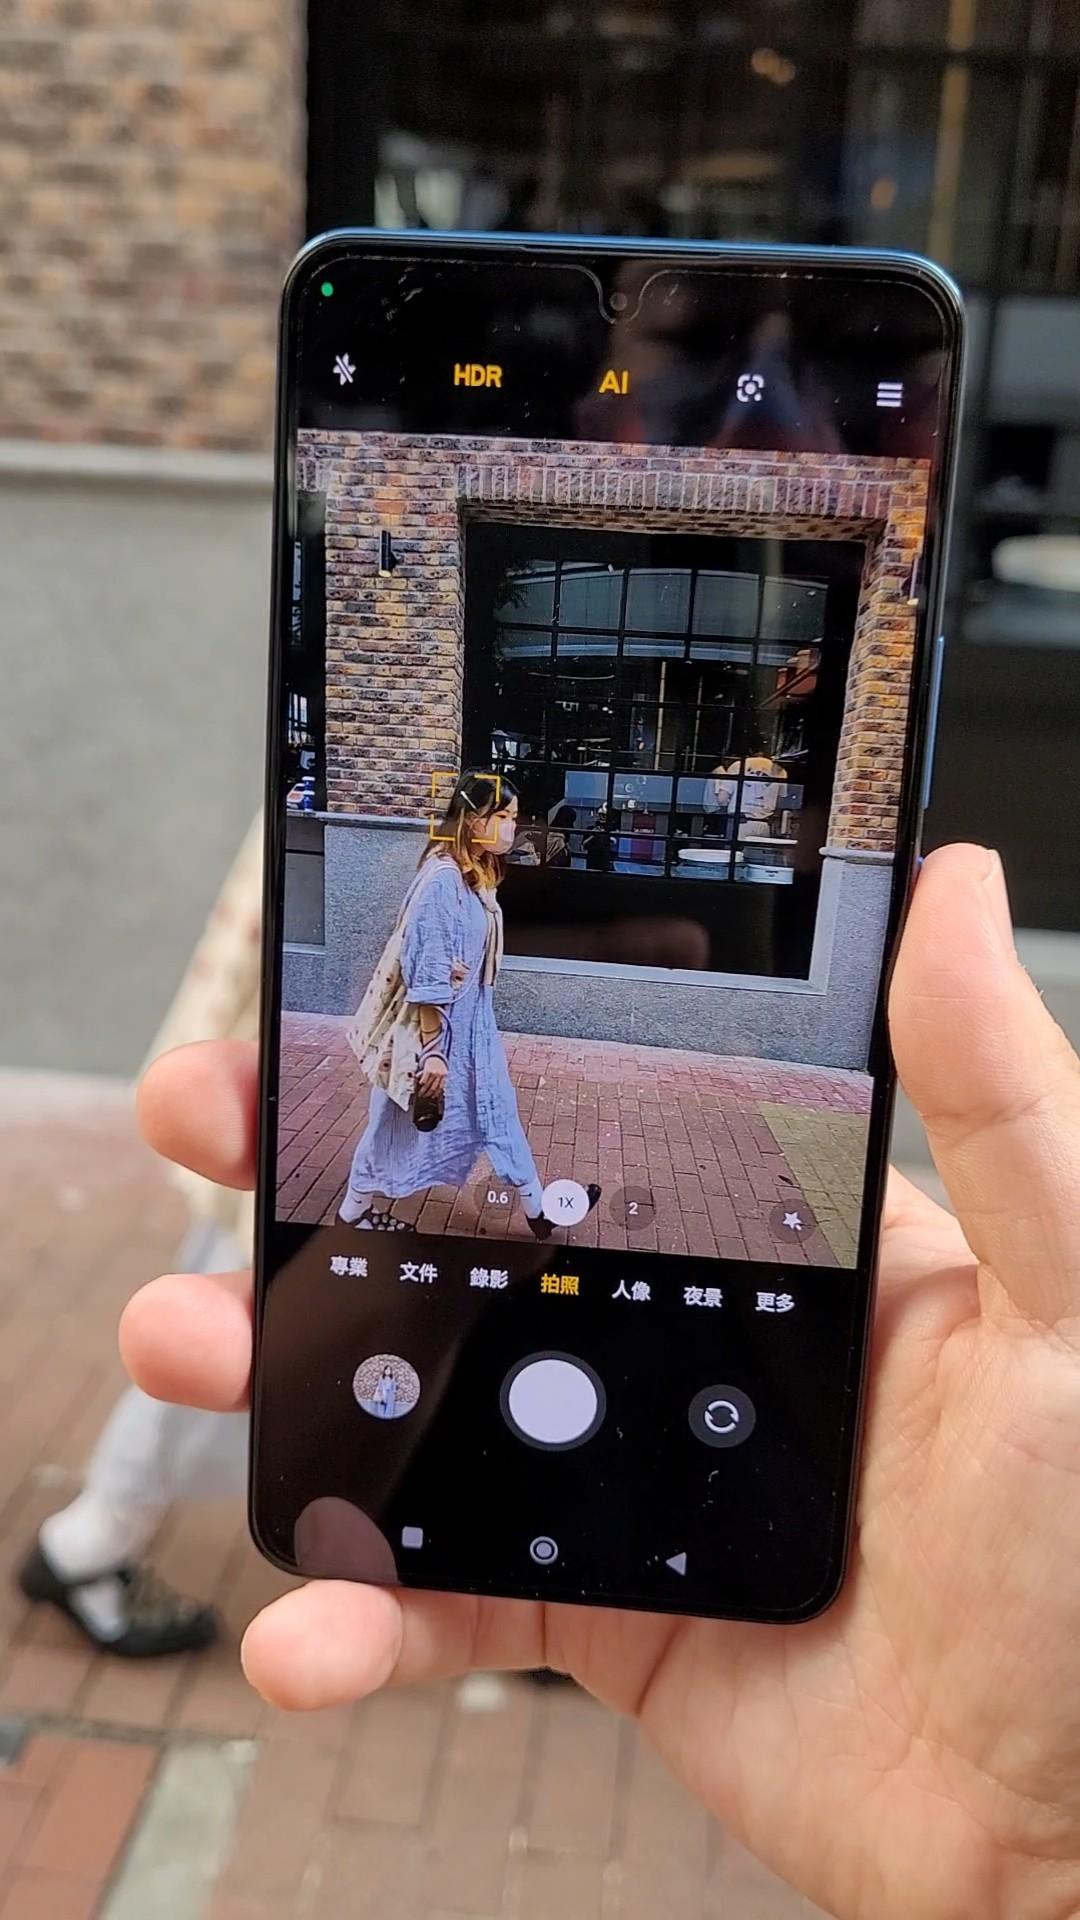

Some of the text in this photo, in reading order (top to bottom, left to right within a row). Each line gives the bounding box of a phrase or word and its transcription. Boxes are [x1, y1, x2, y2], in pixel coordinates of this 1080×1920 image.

[454, 363, 503, 388] HDR
[598, 370, 629, 394] AI
[487, 1190, 509, 1205] 0.6
[558, 1195, 574, 1209] 1X
[628, 1201, 638, 1215] 2
[330, 1256, 795, 1313] 專業 文件 錄影 拍照 人像 夜景 更多
